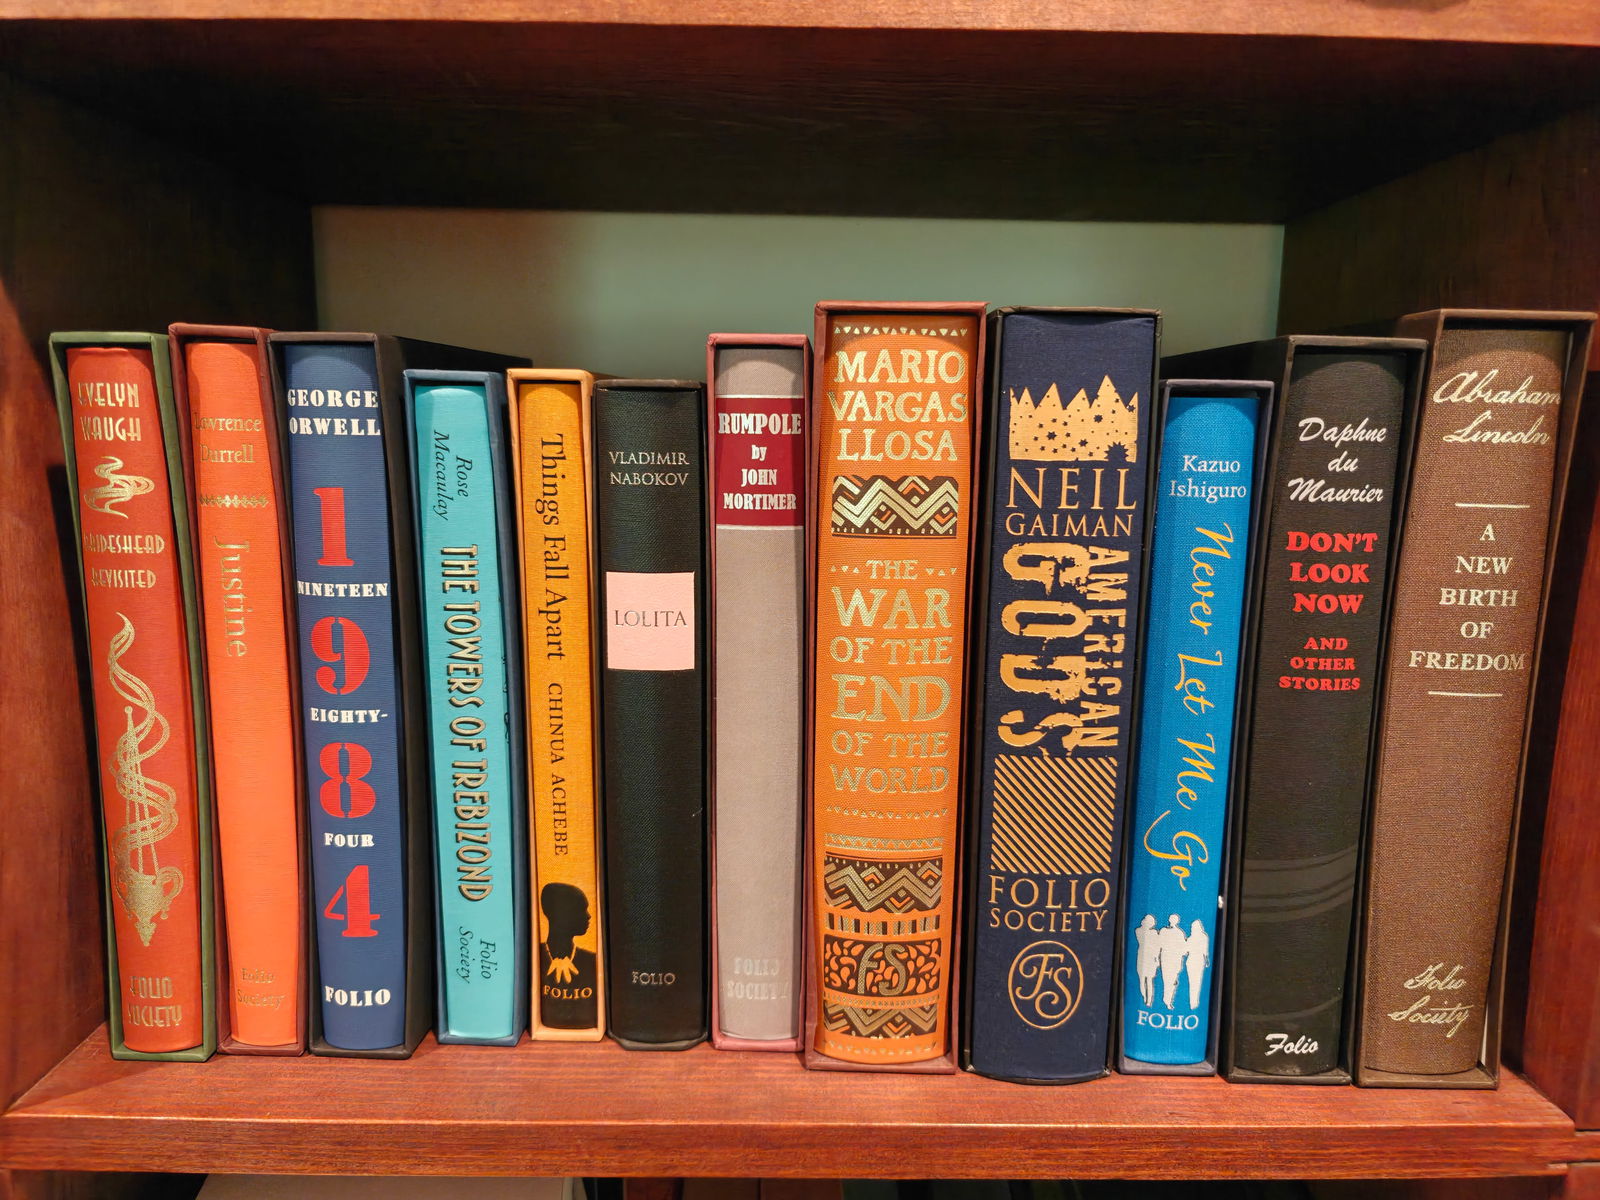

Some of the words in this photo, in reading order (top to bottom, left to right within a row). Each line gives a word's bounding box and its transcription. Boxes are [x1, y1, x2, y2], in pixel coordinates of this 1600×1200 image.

[834, 349, 966, 384] MARIO
[288, 389, 378, 407] GEORGE
[1433, 369, 1560, 404] Abraham
[827, 390, 968, 423] VARGAS
[80, 416, 141, 441] WAUGH
[290, 419, 380, 436] ORWELL
[718, 413, 801, 434] RUMPOLE
[1298, 417, 1387, 448] Daphne
[1442, 410, 1550, 444] Lincoln
[200, 443, 256, 463] Durrell
[608, 452, 689, 465] VLADIMIR
[751, 445, 767, 461] by
[836, 428, 958, 461] LLOSA
[433, 430, 454, 521] Macaulay
[1182, 455, 1240, 473] Kazuo
[1328, 451, 1358, 473] du
[456, 456, 473, 497] Rose
[535, 433, 567, 526] Things
[610, 472, 688, 486] NABOKOV
[741, 469, 777, 486] JOHN
[1006, 467, 1136, 510] NEIL
[1288, 477, 1384, 503] Maurier
[723, 493, 797, 510] MORTIMER
[1170, 479, 1246, 503] Ishiguro
[314, 488, 354, 566] 1
[1005, 513, 1133, 536] GAIMAN
[1480, 523, 1496, 541] A
[1286, 531, 1378, 553] DON'T
[441, 544, 480, 594] THE
[544, 534, 570, 581] Fall
[866, 560, 918, 579] THE
[1455, 556, 1513, 575] NEW
[1190, 522, 1234, 635] Never
[1289, 562, 1370, 584] LOOK
[214, 536, 253, 657] Justine
[298, 581, 388, 597] NINETEEN
[1439, 588, 1518, 607] BIRTH
[831, 586, 952, 629] WAR
[1292, 593, 1364, 614] NOW
[538, 589, 568, 660] Apart
[615, 609, 687, 628] LOLITA
[1460, 621, 1494, 639] OF
[311, 616, 370, 694] 9
[444, 600, 484, 708] TOWERS
[830, 636, 875, 664] OF
[881, 636, 952, 664] THE
[998, 542, 1091, 754] GODS
[1077, 545, 1129, 748] AMERICAN
[1304, 637, 1348, 651] AND
[1290, 657, 1356, 670] OTHER
[1408, 650, 1525, 671] FREEDOM
[1178, 650, 1223, 716] Let
[1279, 676, 1360, 691] STORIES
[831, 674, 951, 722] END
[311, 708, 387, 723] EIGHTY-
[548, 683, 565, 764] CHINUA
[450, 716, 487, 752] OF
[831, 730, 874, 756] OF
[883, 732, 950, 758] THE
[320, 742, 376, 818] 8
[830, 763, 949, 794] WORLD
[1177, 733, 1215, 810] Me
[551, 774, 568, 856] ACHEBE
[324, 833, 374, 847] FOUR
[452, 758, 494, 901] TREBIZOND
[1144, 810, 1208, 891] Go
[324, 865, 380, 937] 4
[988, 875, 1110, 910] FOLIO
[990, 908, 1108, 932] SOCIETY
[457, 926, 473, 984] Society
[480, 939, 496, 980] Folio
[632, 972, 675, 985] FOLIO
[1403, 962, 1467, 990] Folio
[325, 986, 391, 1006] FOLIO
[543, 984, 592, 1000] FOLIO
[1136, 1010, 1198, 1031] FOLIO
[1388, 995, 1474, 1038] Society
[1264, 1033, 1318, 1056] Folio
